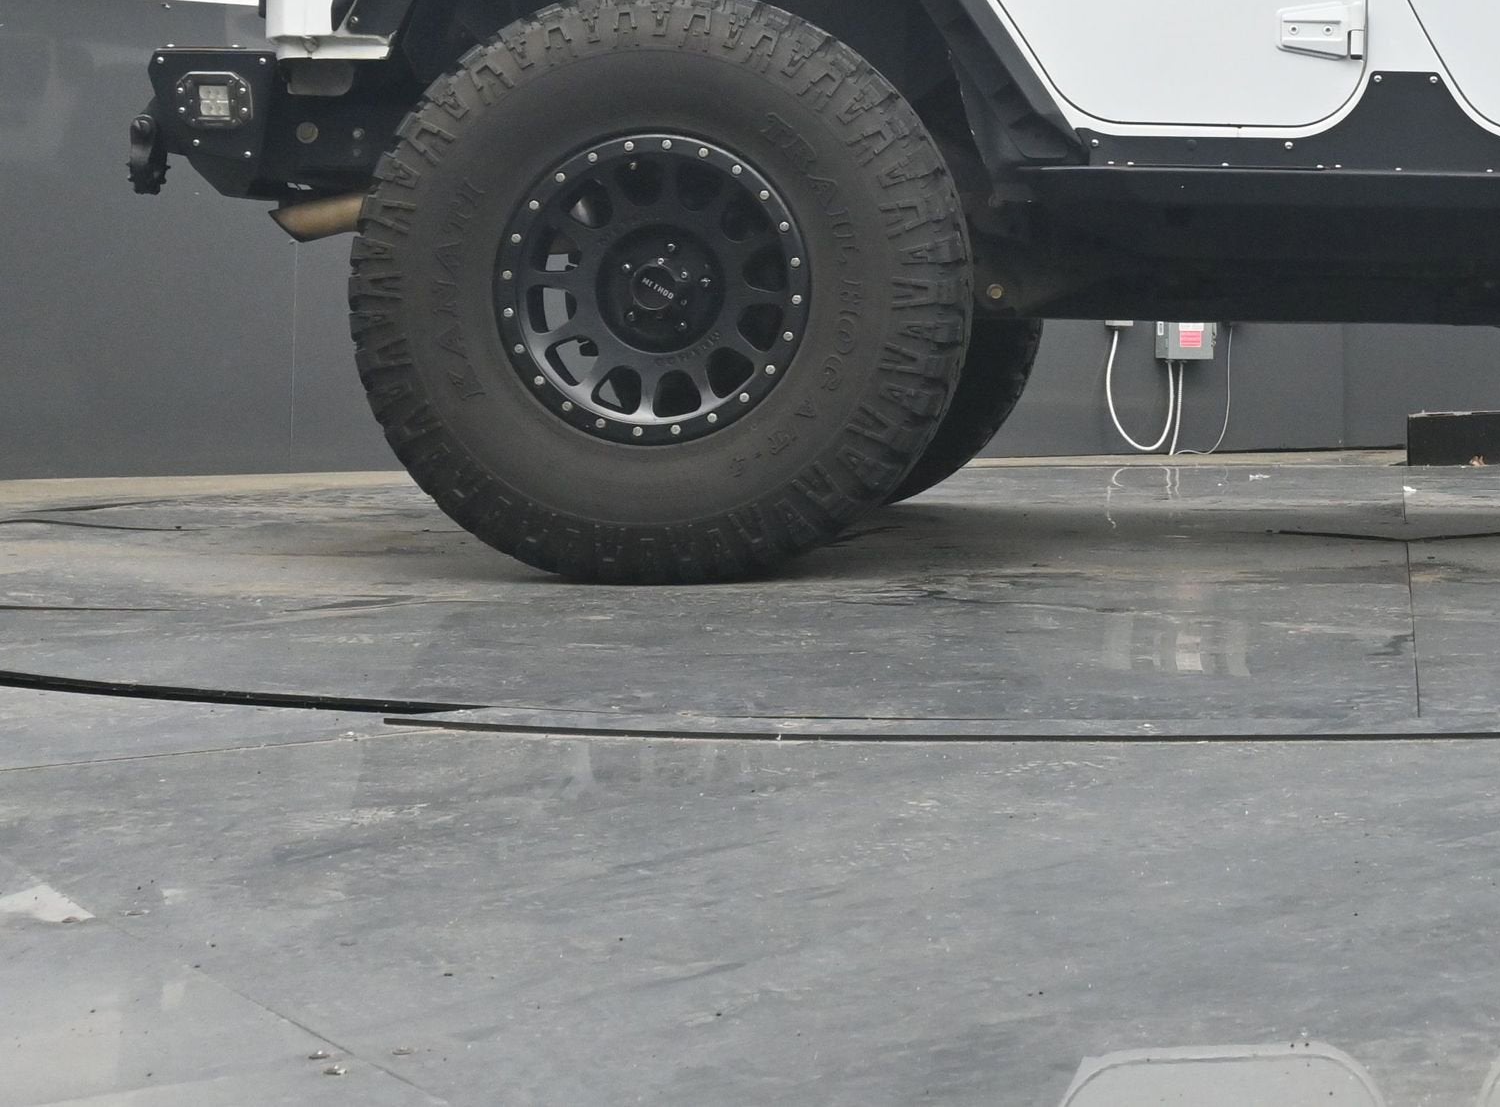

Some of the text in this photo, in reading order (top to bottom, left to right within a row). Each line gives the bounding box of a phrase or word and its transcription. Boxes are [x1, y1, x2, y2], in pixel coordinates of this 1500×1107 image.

[641, 277, 675, 300] METHOD
[760, 112, 859, 264] TRAIL
[822, 278, 864, 390] HOG
